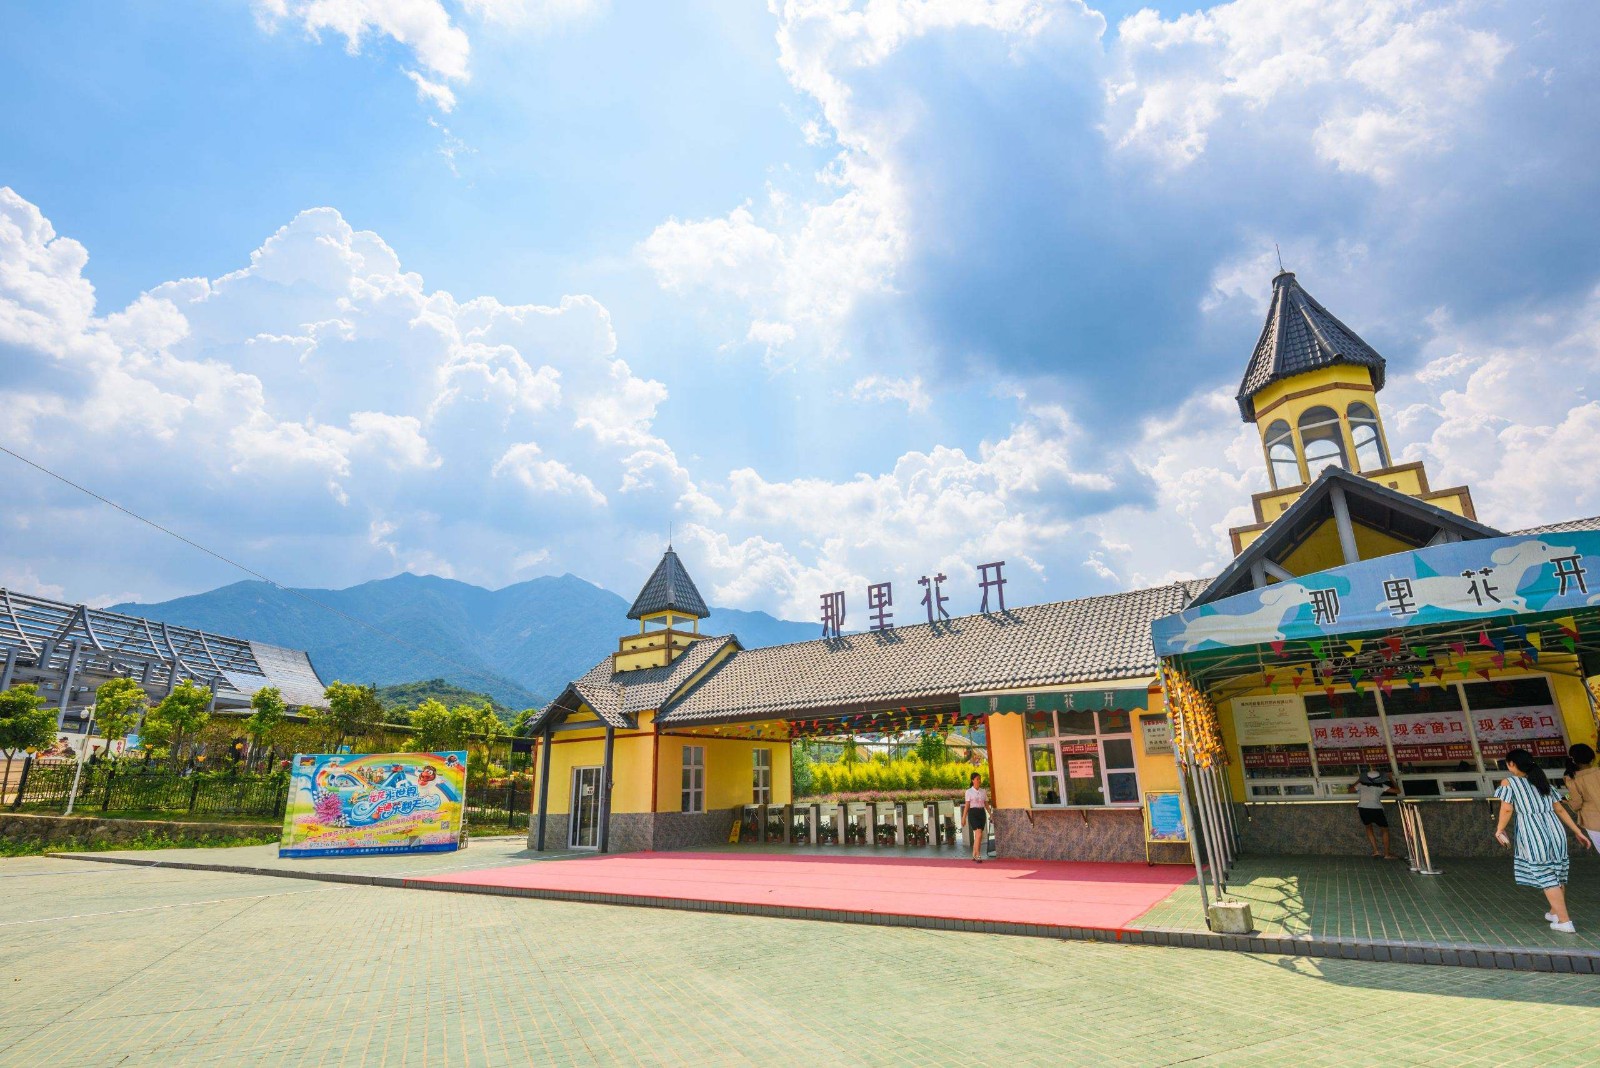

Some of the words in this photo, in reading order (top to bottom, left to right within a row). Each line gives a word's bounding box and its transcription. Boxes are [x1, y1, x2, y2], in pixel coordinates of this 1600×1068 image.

[820, 561, 1007, 637] 那里花开
[1308, 554, 1588, 625] 那里花开
[988, 691, 1115, 712] 那里花开
[1313, 725, 1380, 740] 网络兑换
[1393, 721, 1464, 736] 现金窗口
[1478, 715, 1554, 732] 现金窗口
